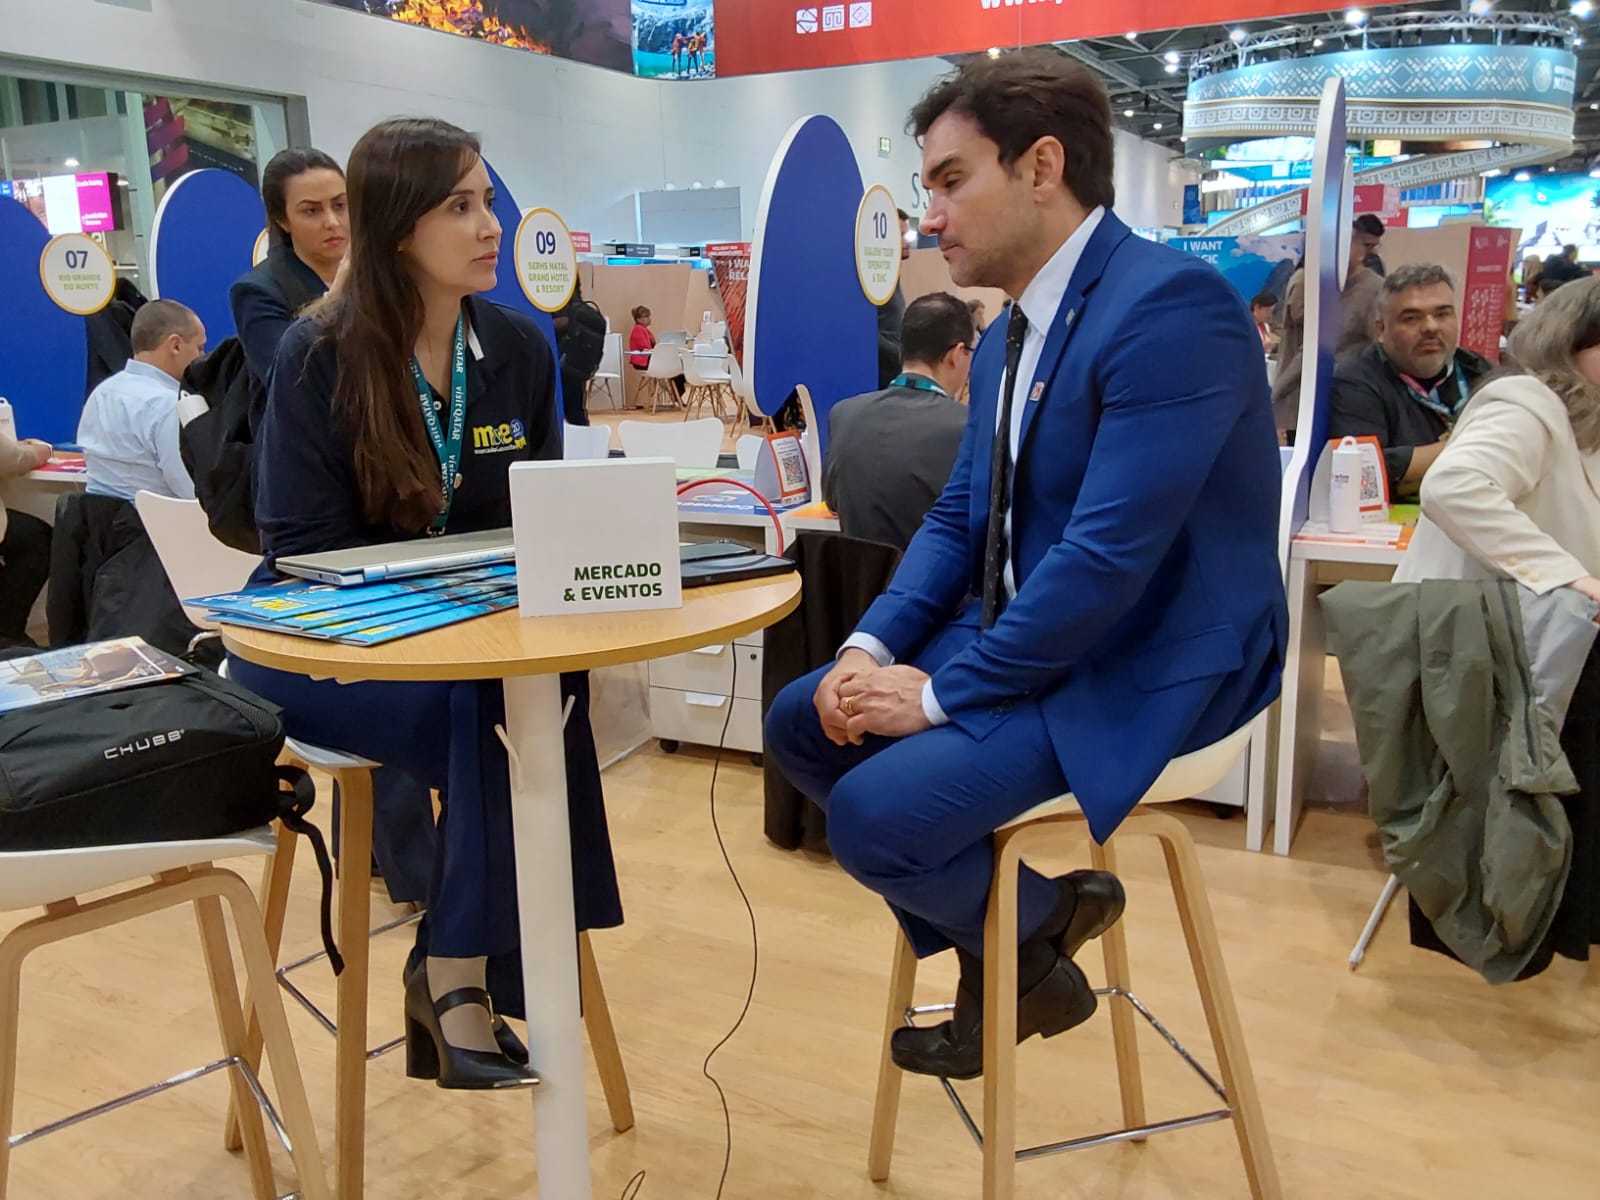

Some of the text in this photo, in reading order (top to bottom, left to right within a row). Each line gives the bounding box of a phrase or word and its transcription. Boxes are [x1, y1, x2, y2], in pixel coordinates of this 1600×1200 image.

[872, 211, 888, 239] 10
[535, 230, 556, 255] 09
[1189, 240, 1223, 251] WANT
[65, 250, 89, 269] 07
[528, 261, 568, 271] SERHS NATAL
[733, 259, 750, 268] WA
[528, 273, 570, 282] GRAND HOTEL
[542, 284, 565, 293] RESORT
[451, 386, 463, 441] visitQATAR
[574, 563, 662, 581] MERCADO
[563, 582, 662, 601] & EVENTOS
[103, 729, 182, 760] CHUBB
